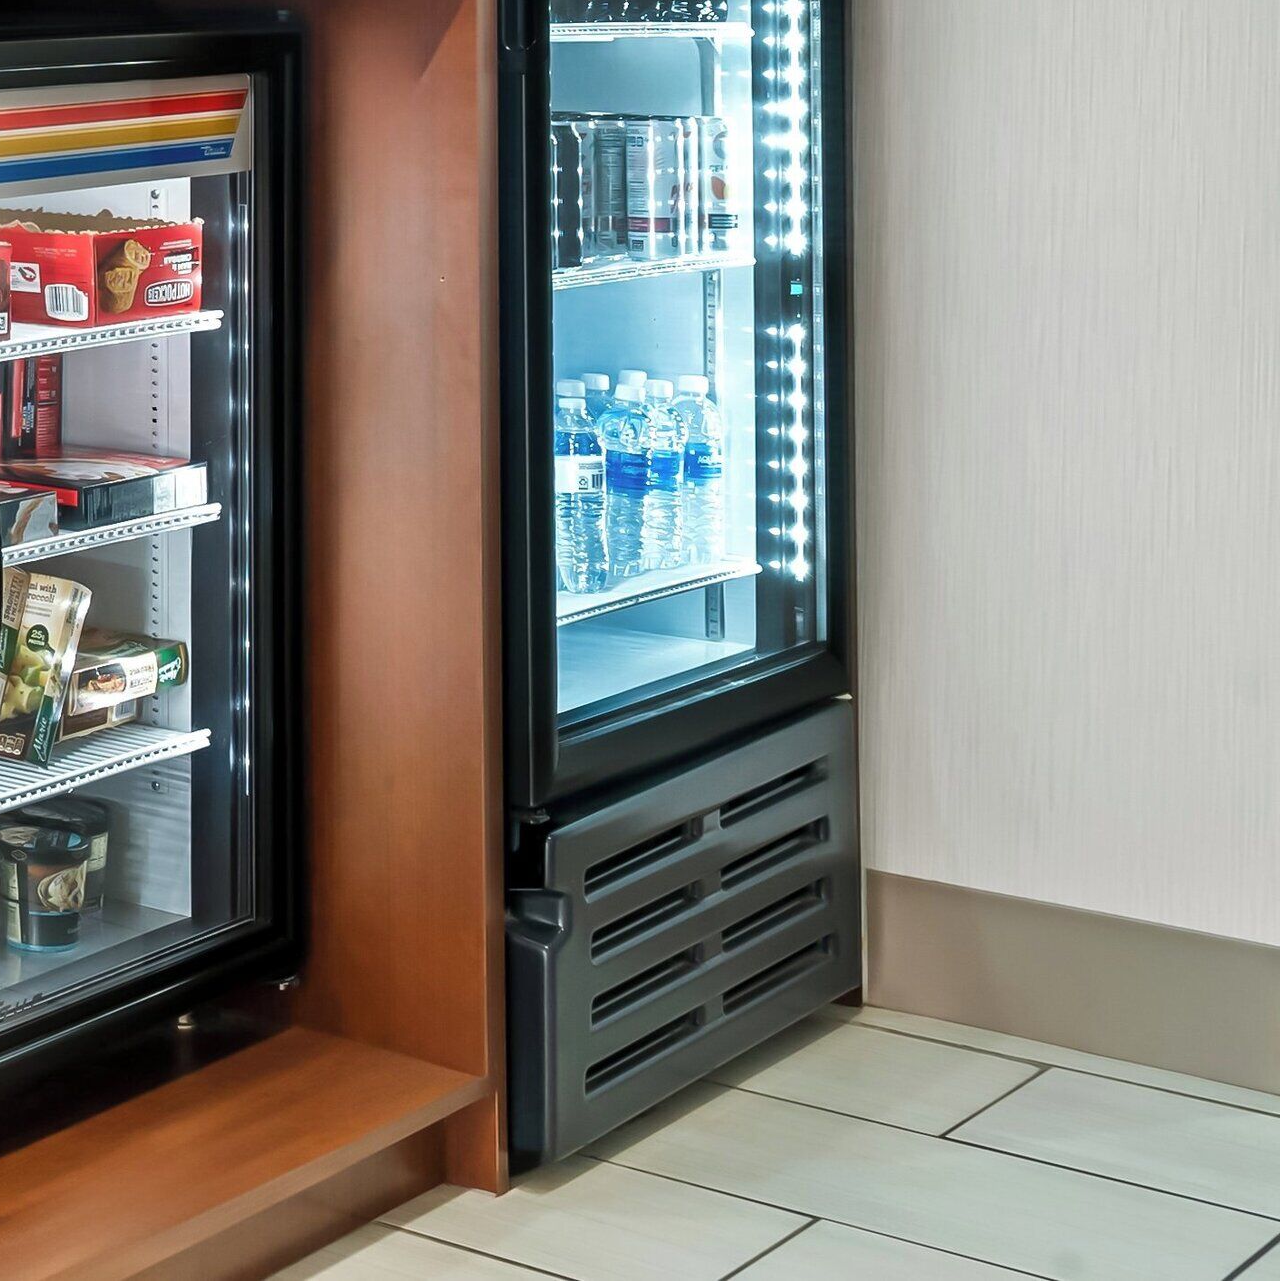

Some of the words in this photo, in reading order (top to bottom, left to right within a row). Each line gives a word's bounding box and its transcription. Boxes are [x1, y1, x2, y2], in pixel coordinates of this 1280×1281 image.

[148, 283, 178, 303] POCKETS
[177, 282, 191, 300] HOT
[40, 583, 57, 594] with
[27, 592, 56, 604] roccoli
